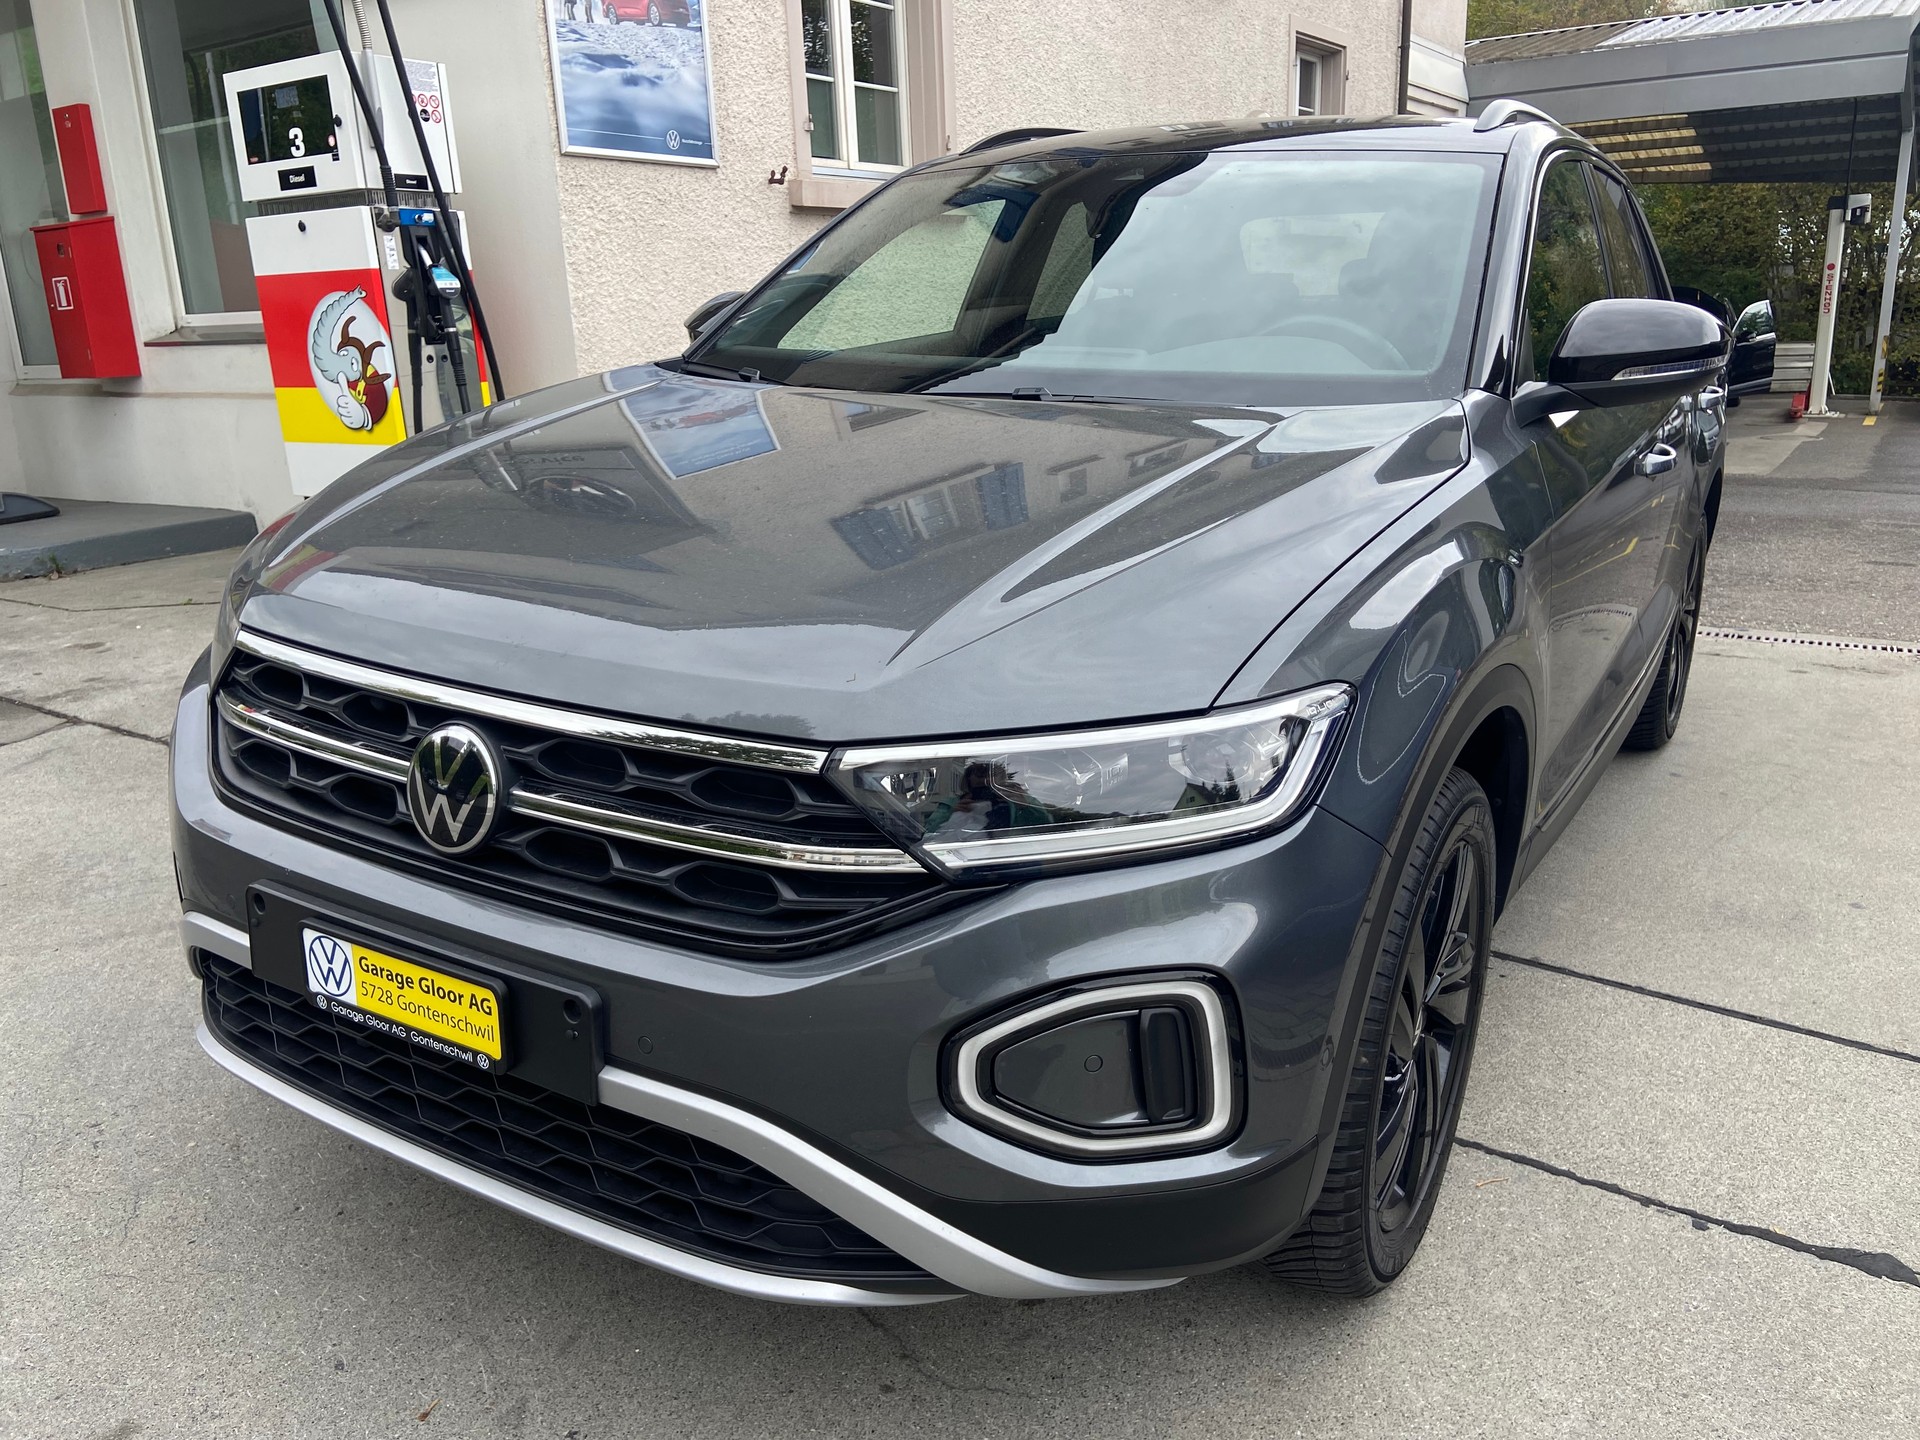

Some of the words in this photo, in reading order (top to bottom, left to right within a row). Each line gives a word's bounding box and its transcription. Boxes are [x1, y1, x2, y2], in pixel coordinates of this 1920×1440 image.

[288, 126, 305, 158] 3
[289, 173, 306, 183] Diesel
[309, 935, 352, 997] VW
[358, 955, 415, 990] Garage
[418, 976, 465, 1006] Gloor
[468, 992, 493, 1016] AG
[330, 1001, 365, 1023] Garage
[365, 1014, 390, 1032] Gloor
[391, 1024, 407, 1038] AG
[410, 1030, 473, 1063] Gontenschwil
[361, 980, 394, 1006] 5728
[396, 994, 495, 1042] Gontenschwil
